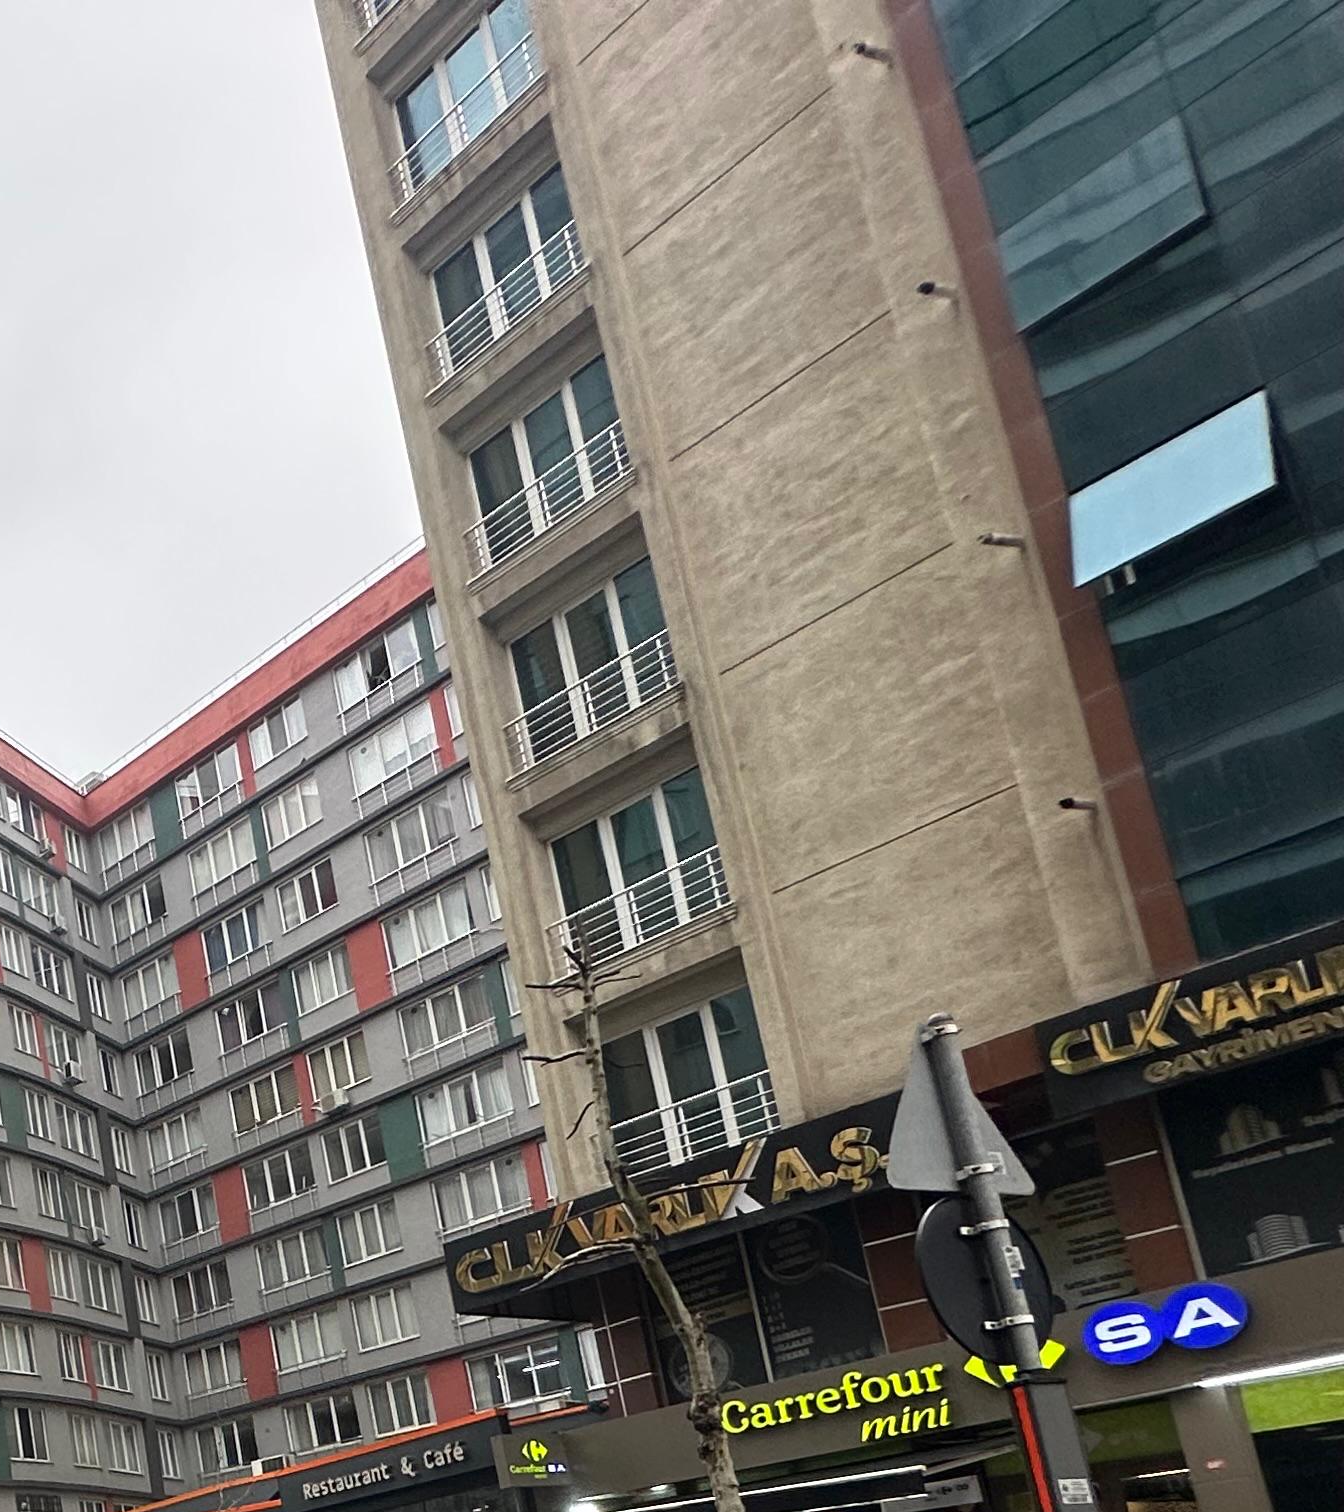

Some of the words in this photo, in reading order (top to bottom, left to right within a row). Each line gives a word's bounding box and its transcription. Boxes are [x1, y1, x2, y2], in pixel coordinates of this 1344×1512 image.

[1050, 978, 1181, 1075] CLK
[455, 1201, 570, 1294] CLK
[720, 1362, 945, 1434] Carrefour
[861, 1397, 951, 1442] mini
[302, 1462, 390, 1500] Restaurant
[400, 1456, 416, 1478] &
[423, 1440, 465, 1470] Café
